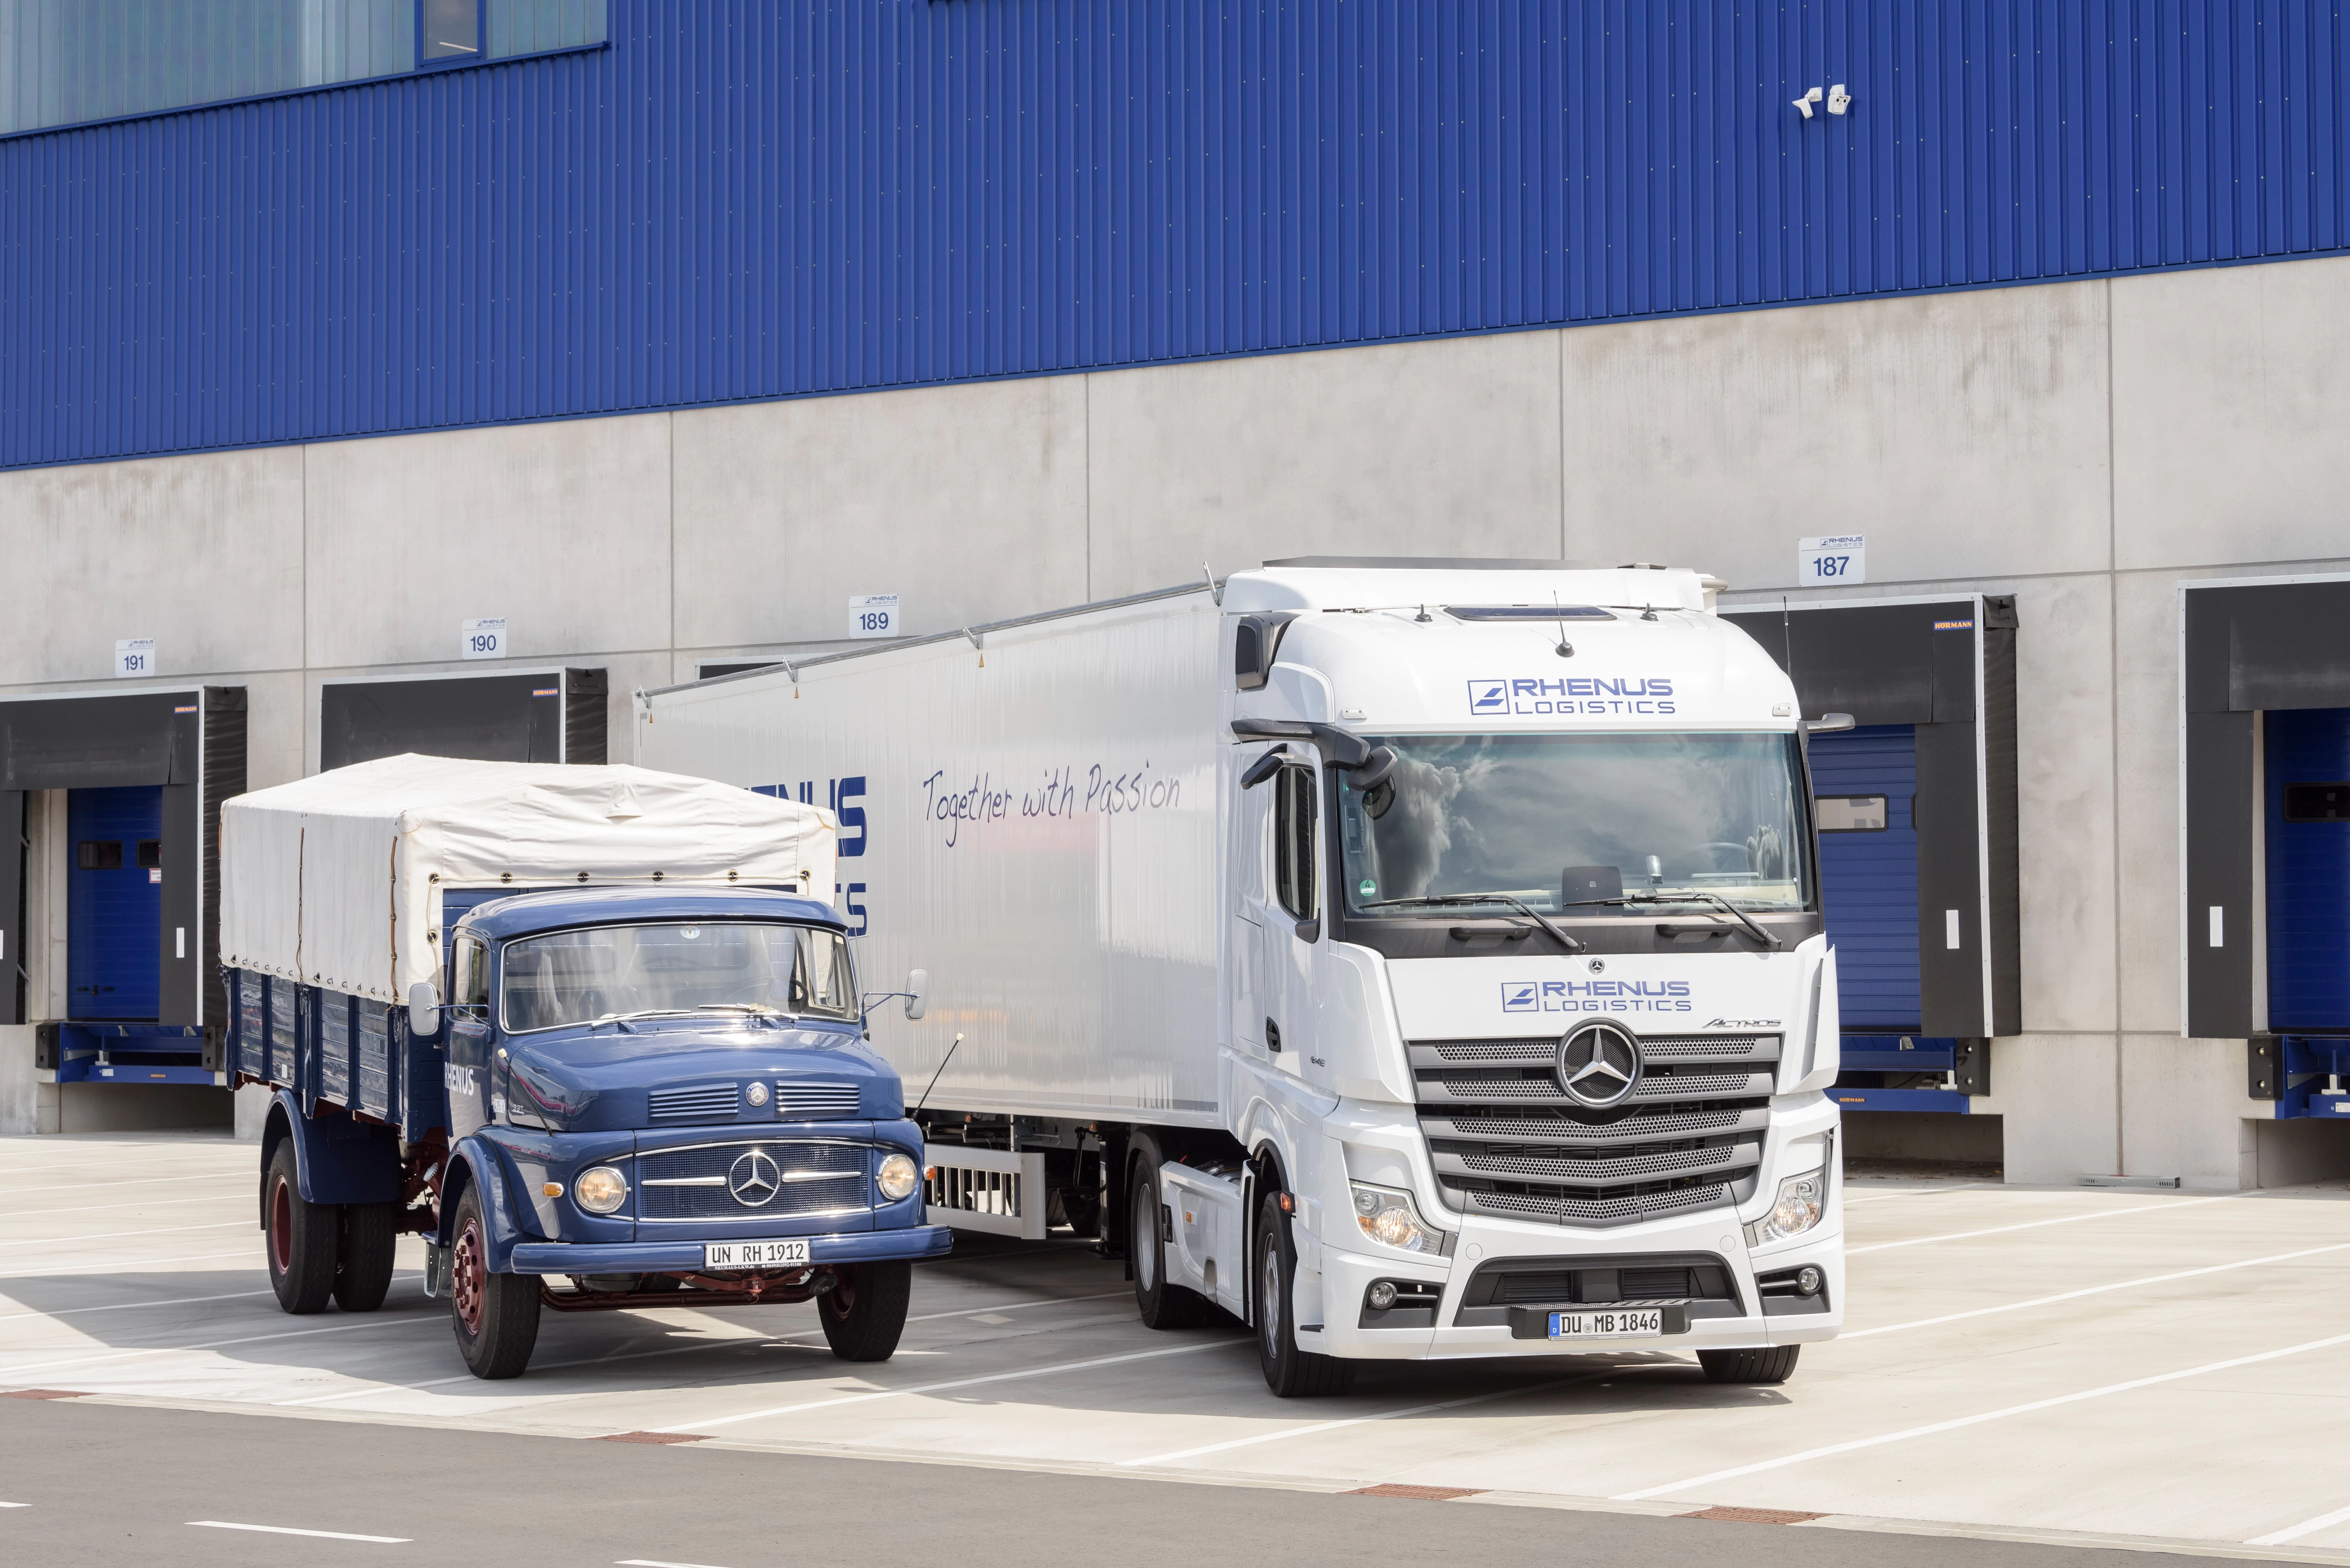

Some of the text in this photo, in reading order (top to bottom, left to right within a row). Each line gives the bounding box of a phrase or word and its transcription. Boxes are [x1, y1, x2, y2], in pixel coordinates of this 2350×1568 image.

[1813, 556, 1850, 576] 187
[860, 612, 888, 630] 189
[470, 635, 496, 651] 190
[124, 655, 143, 670] 191
[1512, 678, 1673, 696] RHENUS
[1515, 701, 1675, 714] LOGISTICS
[923, 770, 1012, 847] Together
[1023, 765, 1074, 819] with
[1085, 758, 1179, 815] Passion
[1542, 981, 1690, 997] RHENUS
[1544, 1000, 1691, 1012] LOGISTICS
[445, 1061, 474, 1096] RHENUS
[712, 1243, 804, 1263] UN RH 1912
[1561, 1312, 1658, 1333] DU MB 1846
